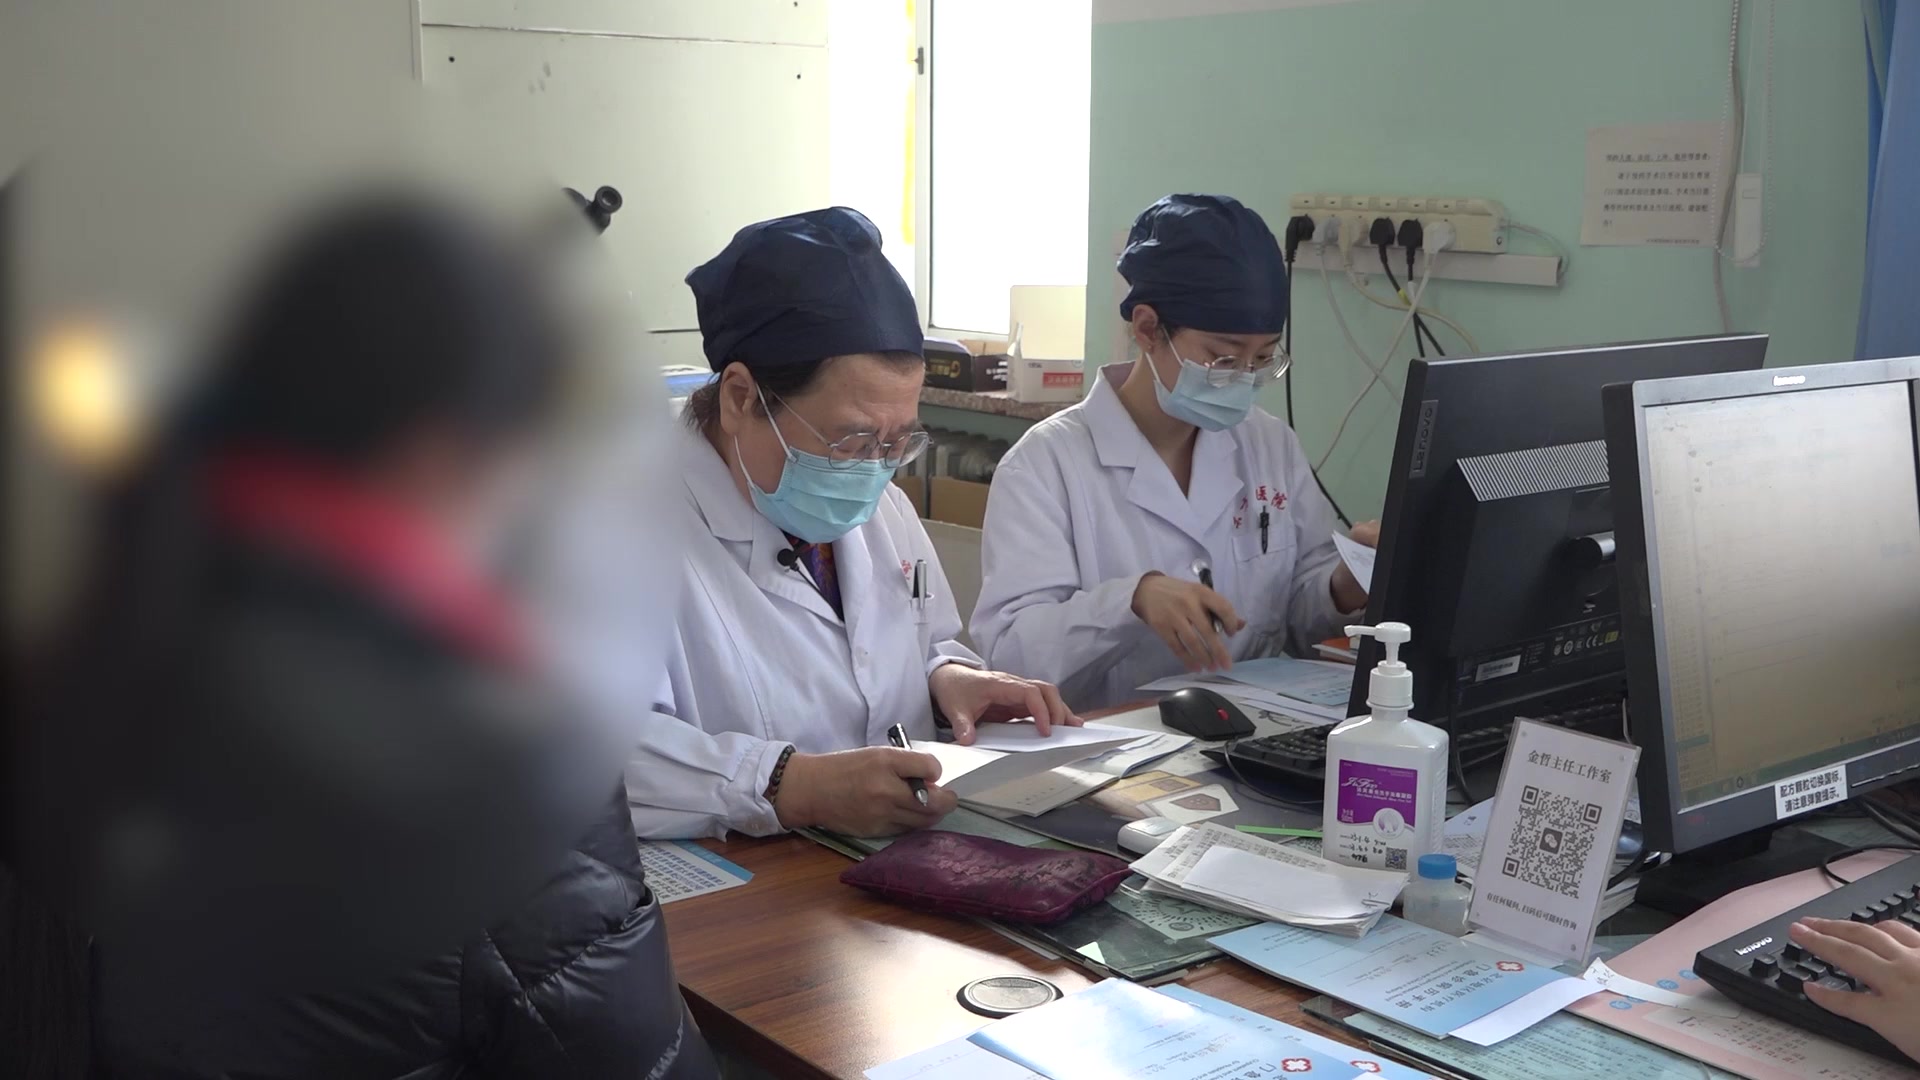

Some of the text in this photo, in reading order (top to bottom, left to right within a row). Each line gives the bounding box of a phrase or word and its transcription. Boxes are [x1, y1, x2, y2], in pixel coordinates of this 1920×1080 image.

[1527, 749, 1612, 784] 金哲主任工作室
